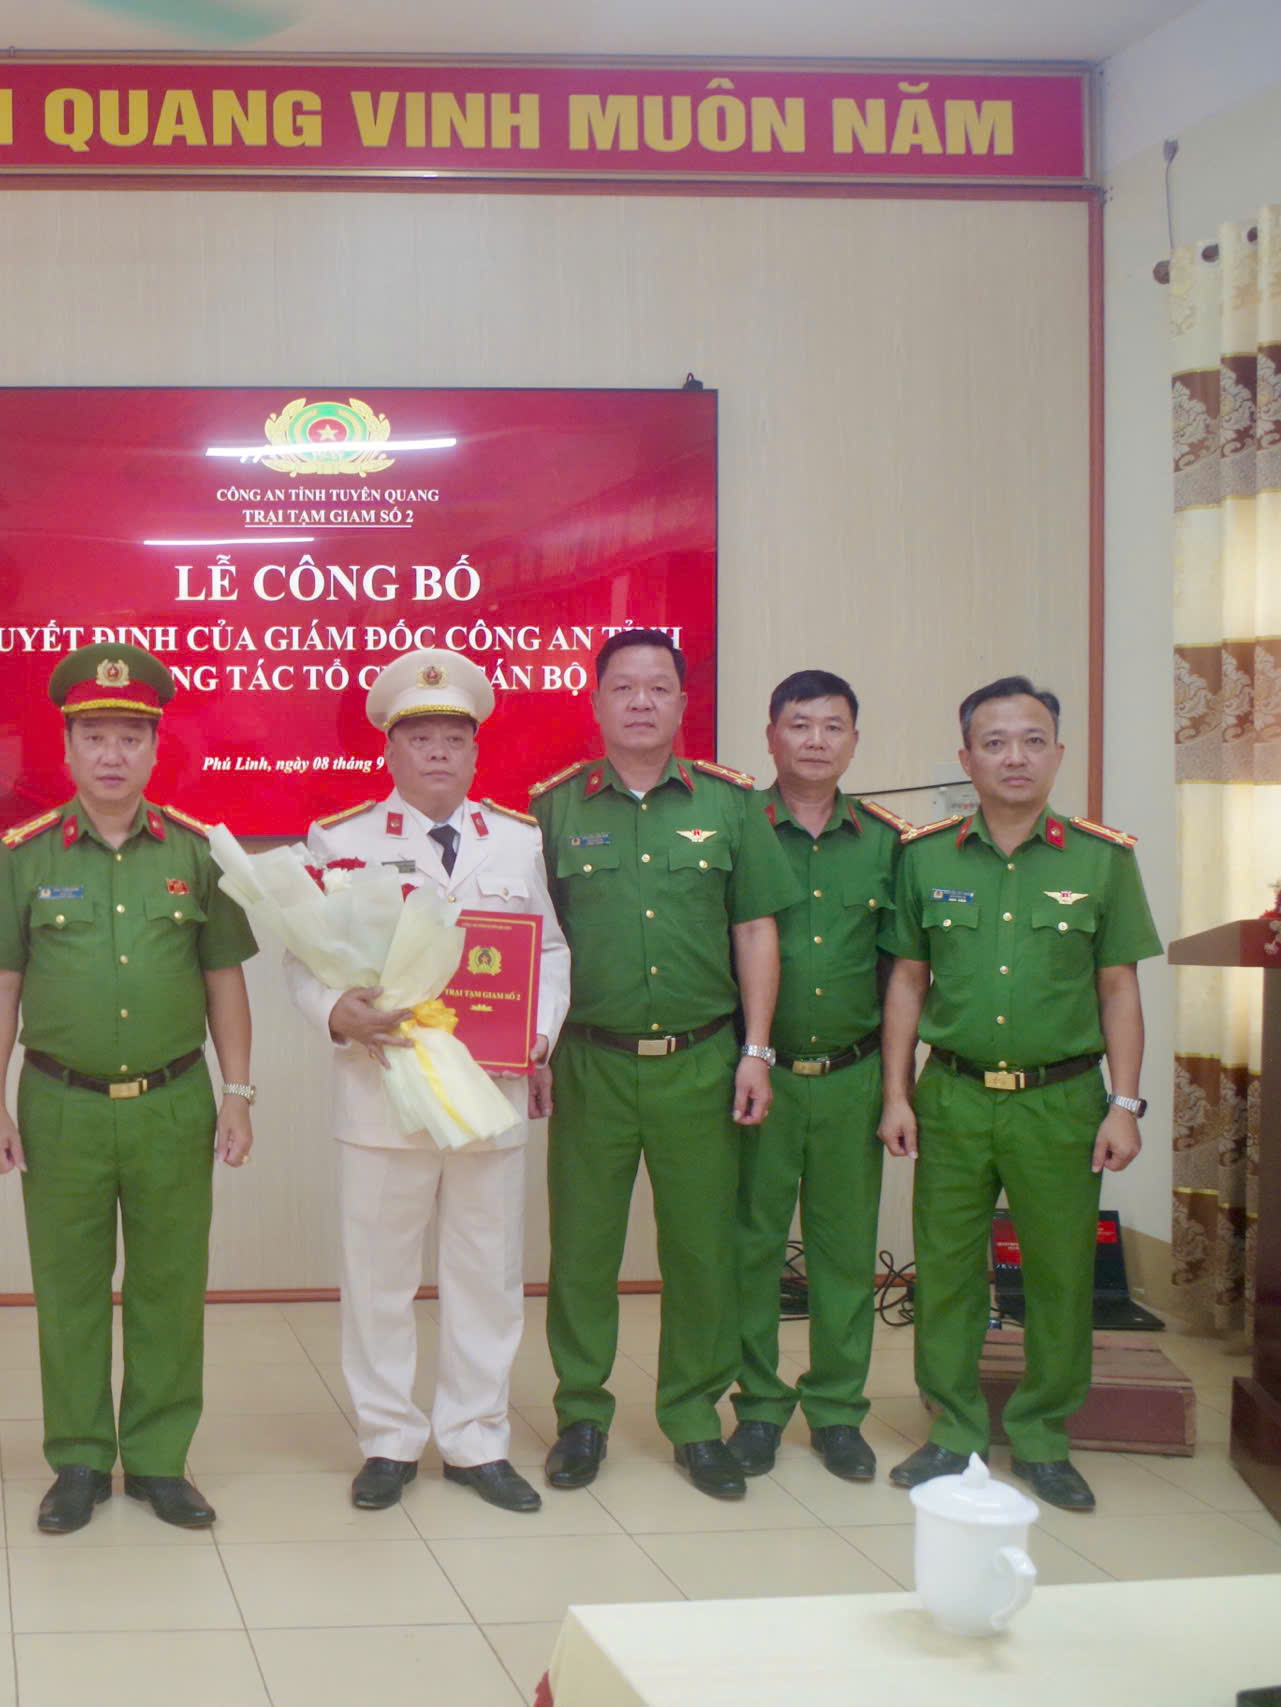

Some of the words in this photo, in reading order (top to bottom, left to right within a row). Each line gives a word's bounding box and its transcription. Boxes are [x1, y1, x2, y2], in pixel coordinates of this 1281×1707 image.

[43, 87, 323, 152] QUANG
[350, 90, 540, 149] VINH
[568, 78, 805, 153] MUÔN
[832, 82, 1013, 155] NĂM
[217, 486, 261, 502] CÔNG
[264, 489, 285, 501] AN
[289, 486, 325, 502] TỈNH
[330, 486, 381, 502] TUYÊN
[384, 489, 439, 504] QUANG
[242, 509, 283, 525] TRẠI
[287, 509, 327, 525] TẠM
[329, 509, 377, 523] GIAM
[380, 506, 402, 523] SỐ
[405, 510, 414, 523] 2
[174, 555, 239, 601] LỄ
[253, 554, 400, 602] CÔNG
[411, 554, 481, 602] BỐ
[185, 619, 259, 652] CỦA
[263, 619, 356, 651] GIÁM
[365, 619, 437, 651] ĐỐC
[445, 619, 542, 651] CÔNG
[548, 626, 594, 650] AN
[169, 665, 219, 691] NG
[226, 659, 296, 691] TÁC
[303, 658, 350, 691] TỔ
[477, 658, 540, 691] ÁN
[543, 662, 588, 697] BỘ
[202, 756, 231, 770] Phú
[234, 756, 272, 772] Linh,
[275, 756, 310, 773] ngày
[312, 757, 329, 770] 08
[332, 756, 373, 773] tháng
[375, 757, 385, 770] 9
